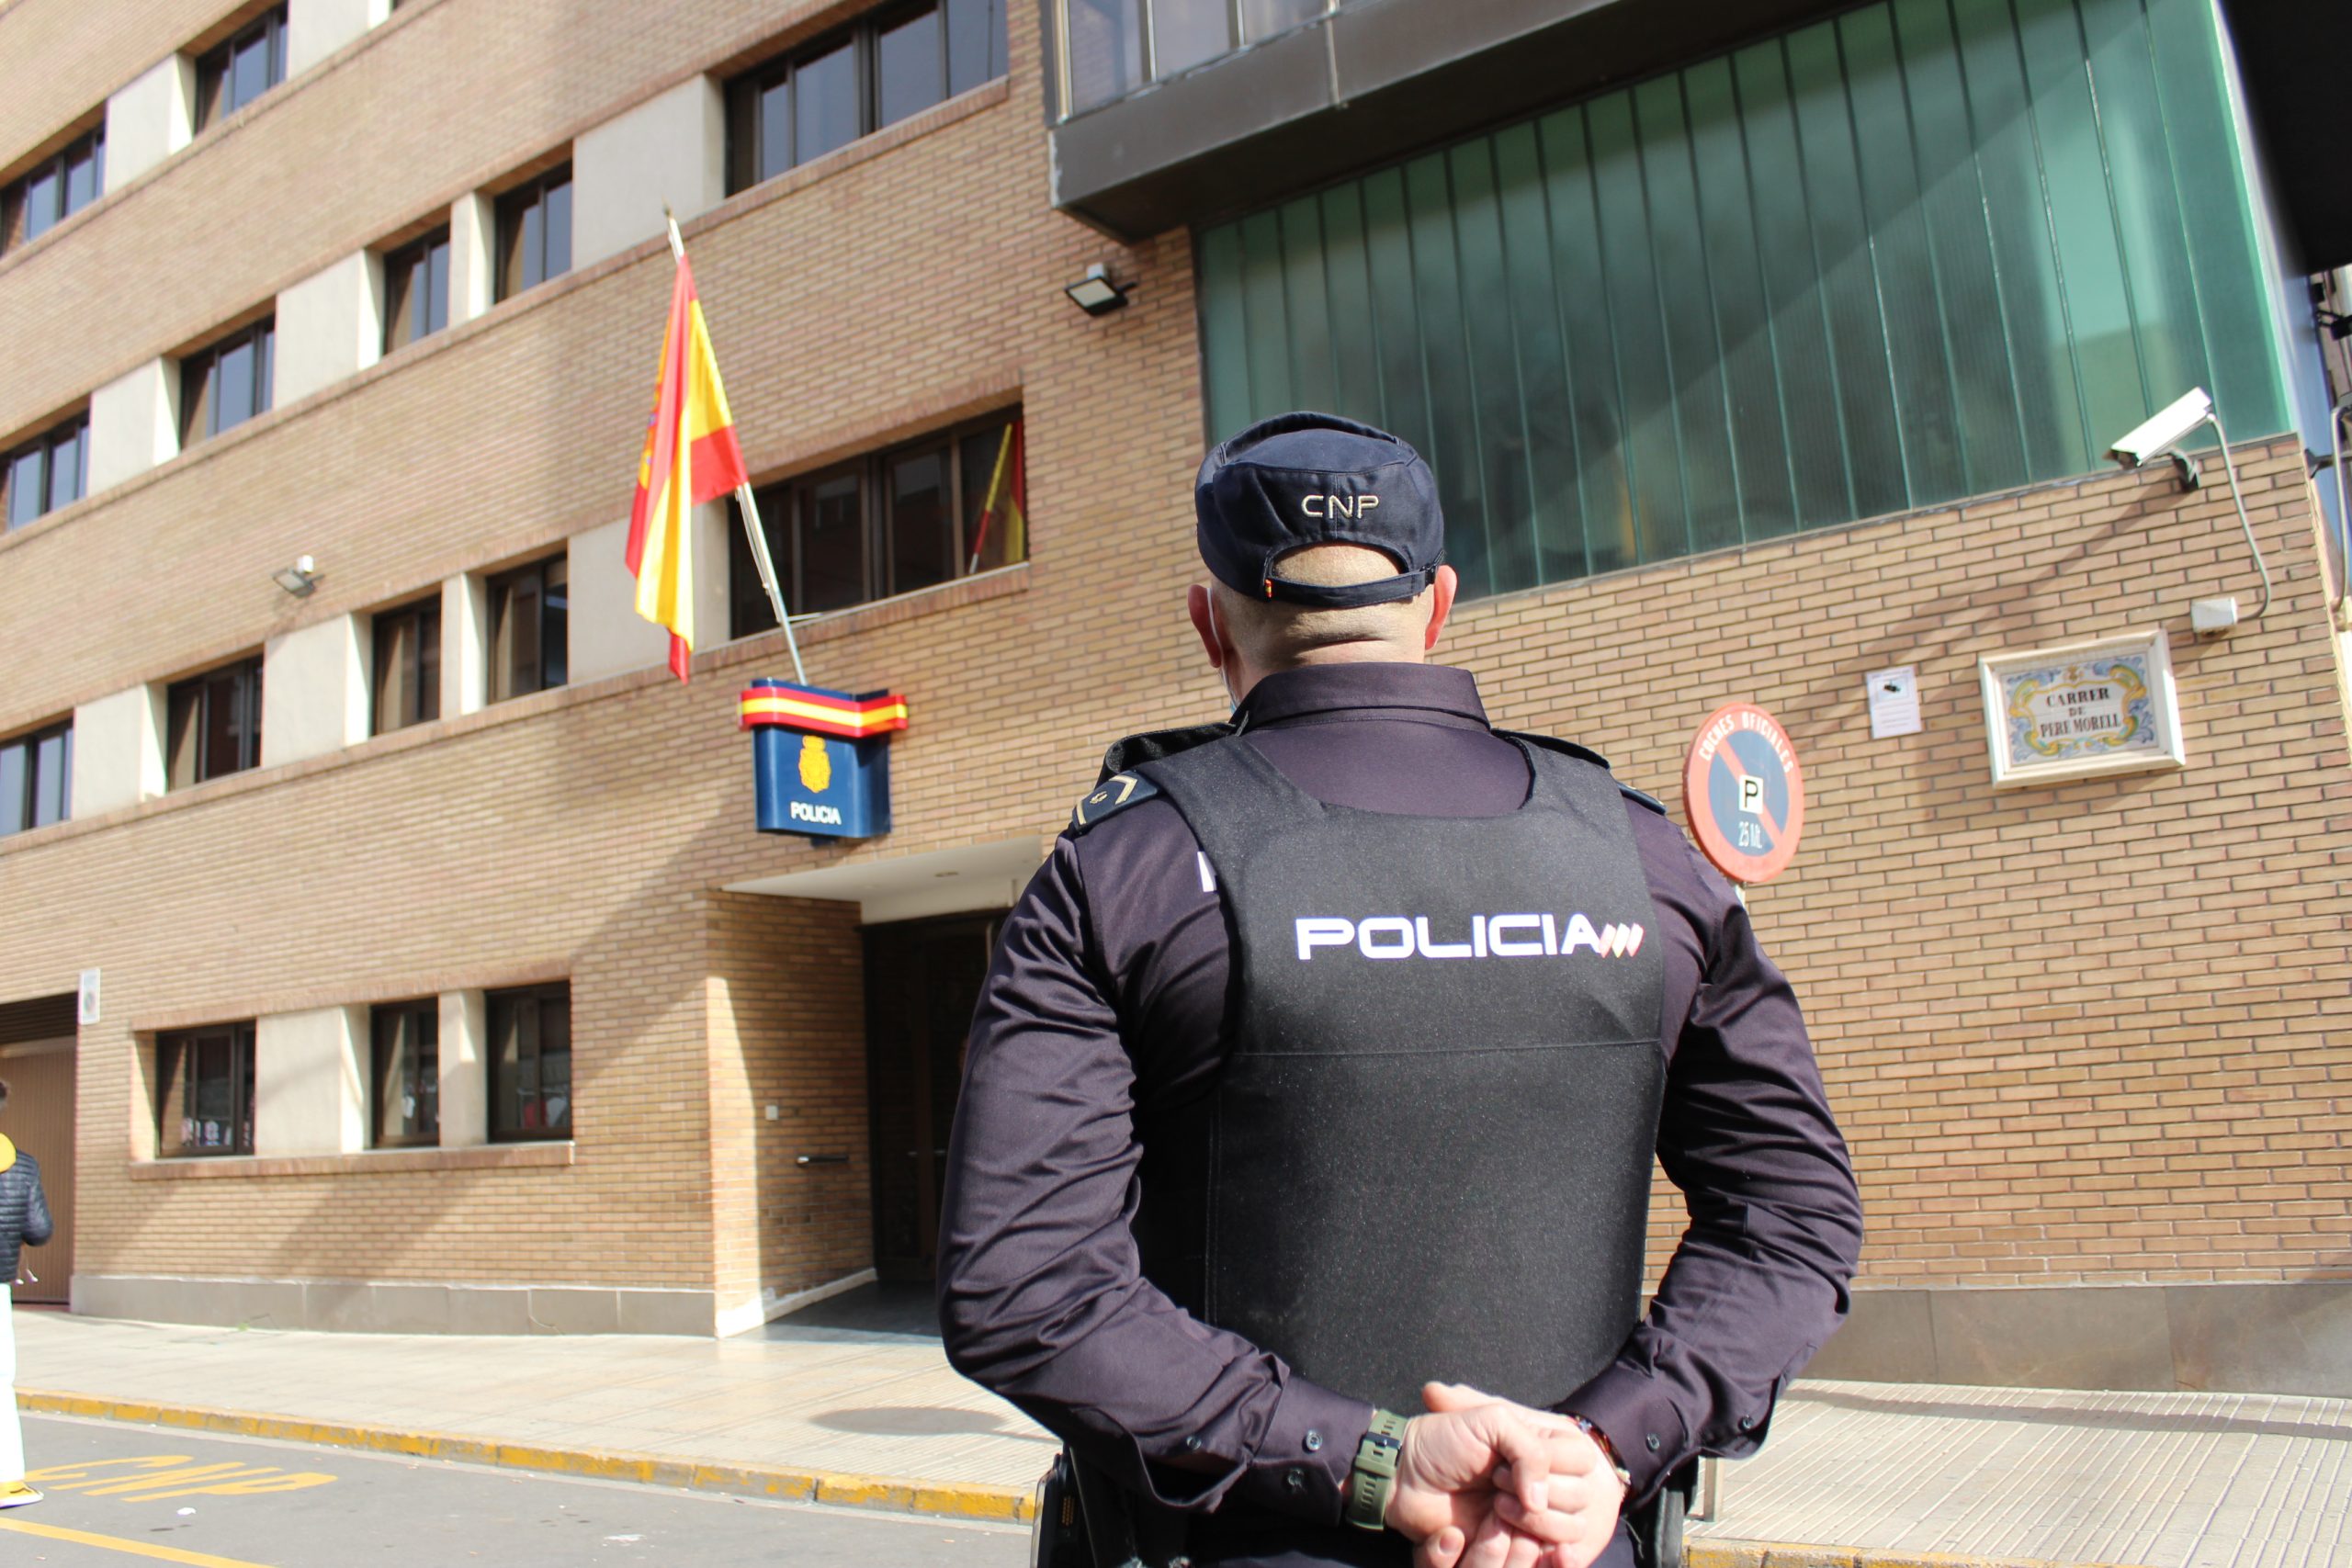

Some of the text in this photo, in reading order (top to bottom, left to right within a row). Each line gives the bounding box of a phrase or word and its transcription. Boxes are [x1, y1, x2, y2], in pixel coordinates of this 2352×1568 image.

[1301, 494, 1380, 519] CNP
[2046, 687, 2109, 707] CARRER
[2069, 706, 2085, 717] DE
[2040, 713, 2121, 738] PERE MORELL
[1698, 711, 1794, 773] COCHES OFICIALES
[1745, 779, 1758, 808] P
[790, 800, 842, 826] POLICIA
[1295, 913, 1602, 960] POLICIA
